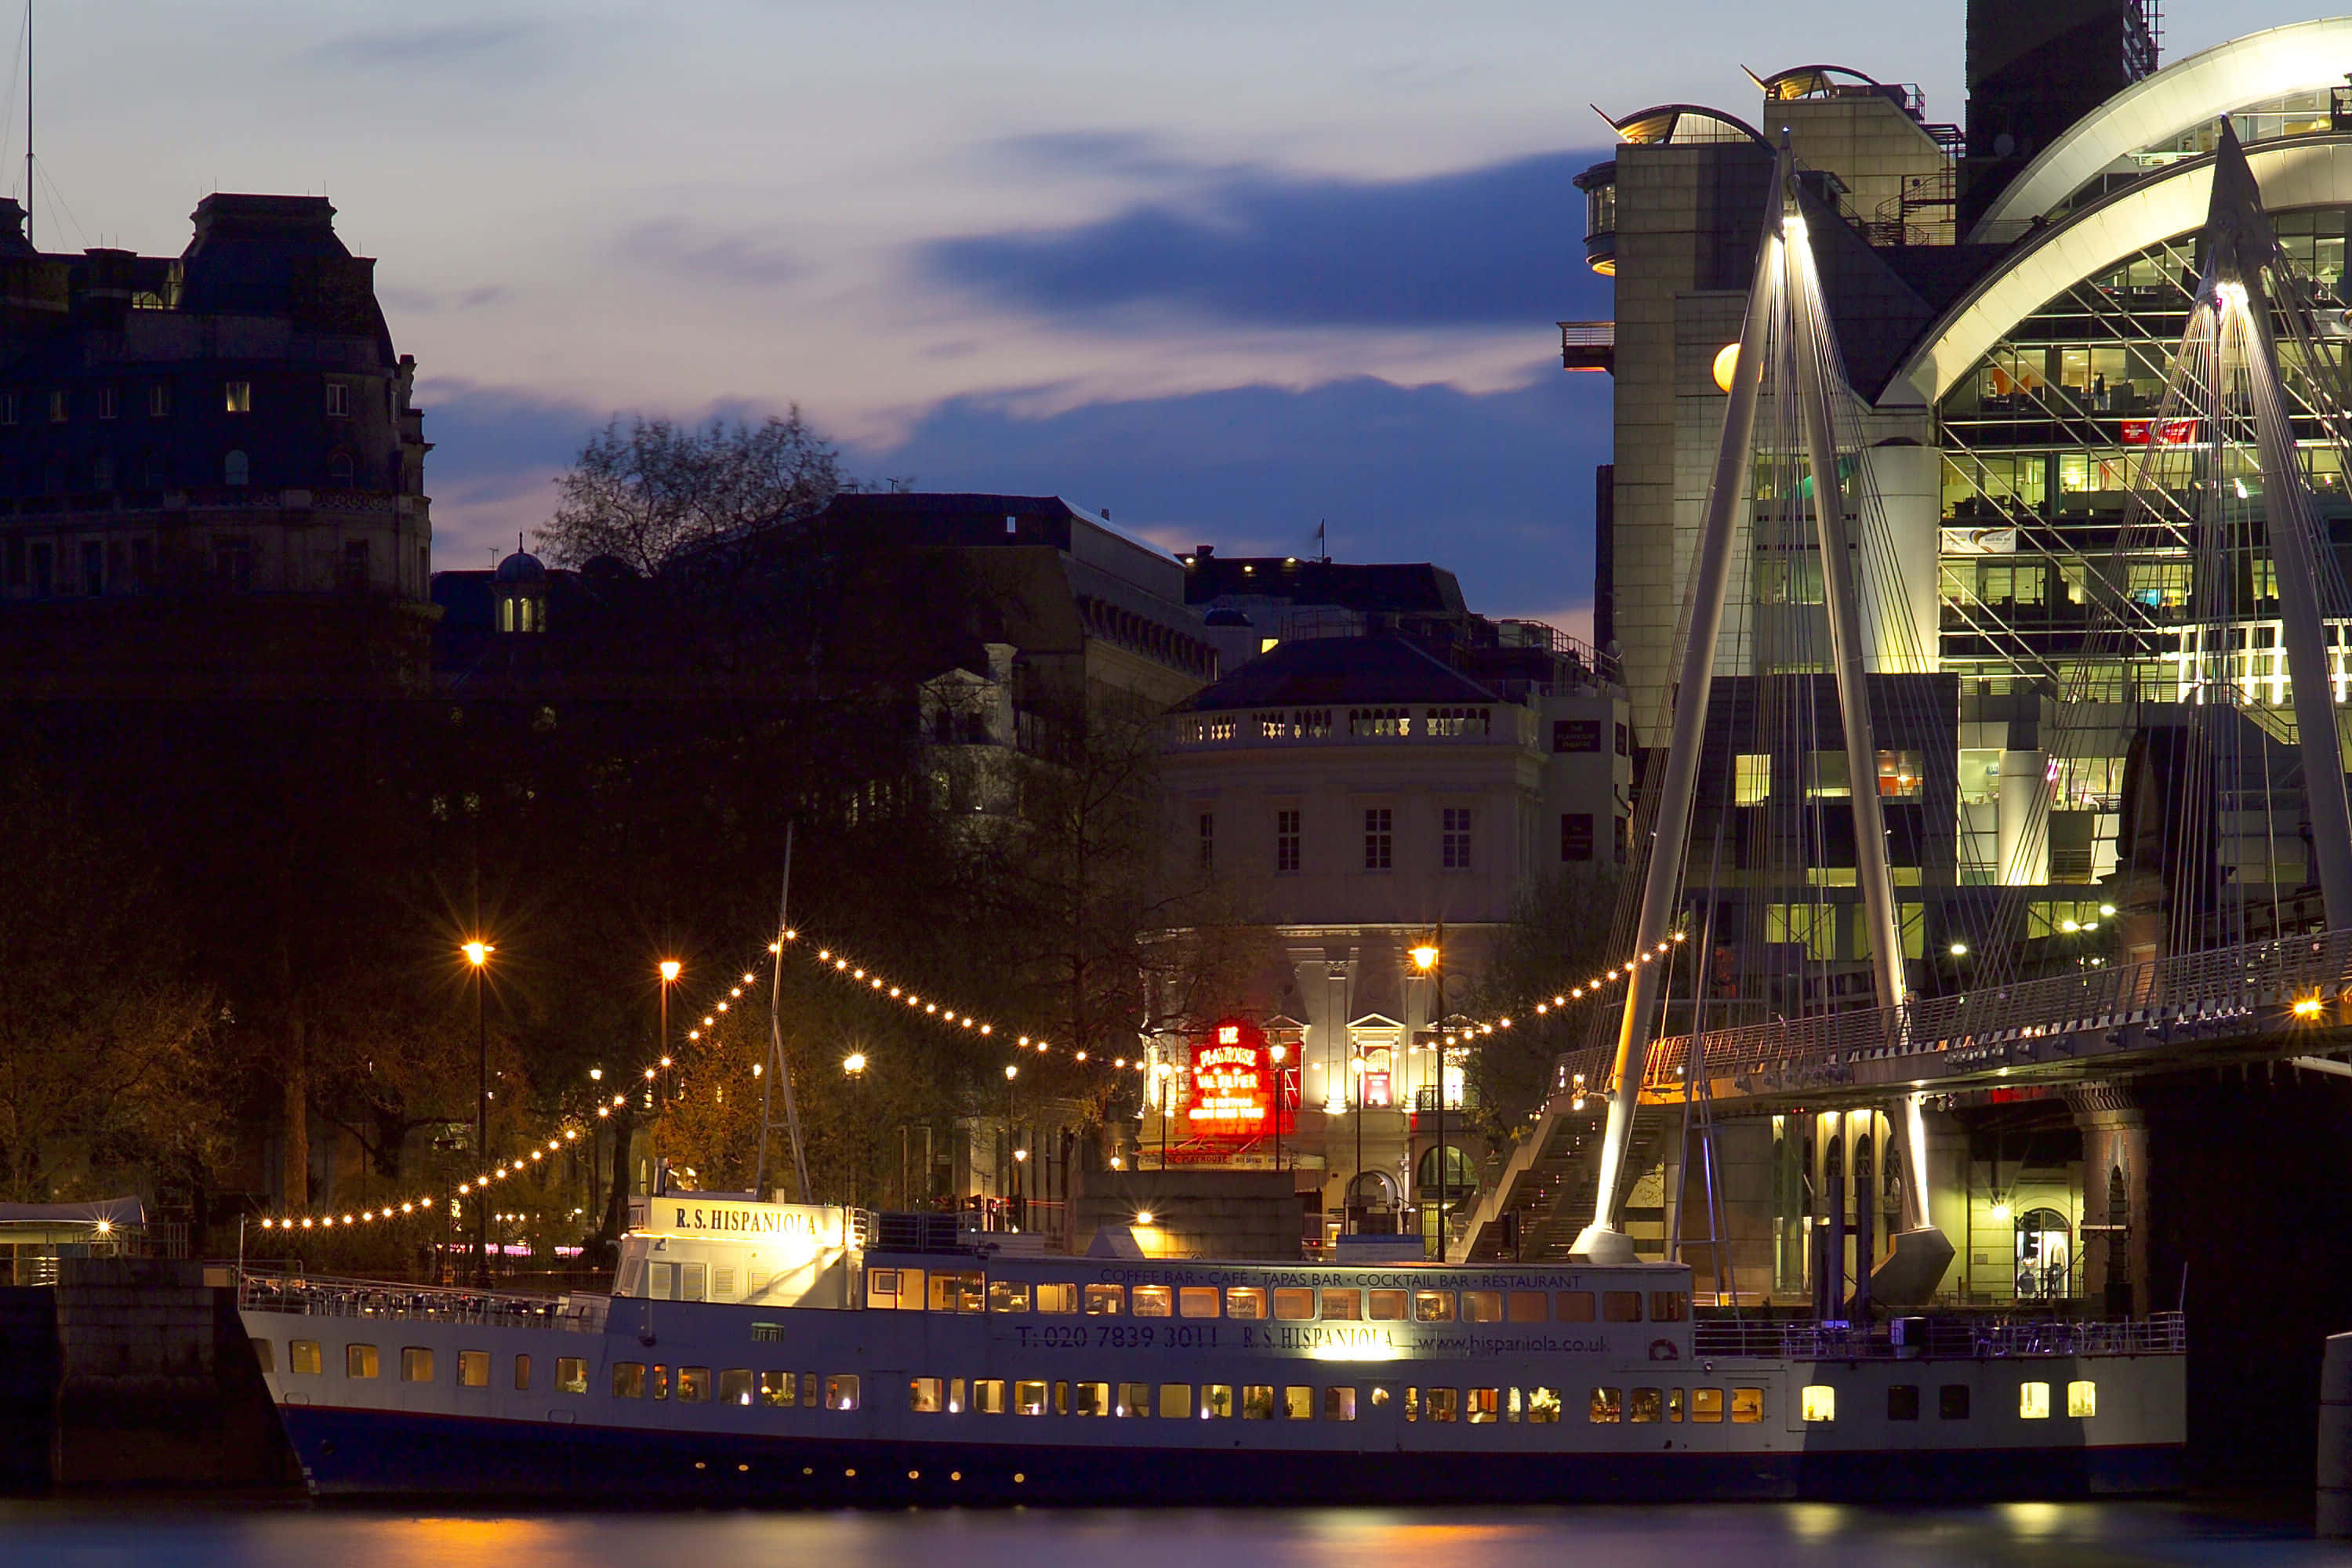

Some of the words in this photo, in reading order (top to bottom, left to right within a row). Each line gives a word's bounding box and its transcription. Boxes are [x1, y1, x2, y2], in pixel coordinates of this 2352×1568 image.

[1219, 1026, 1238, 1044] THE
[1200, 1047, 1256, 1068] PLAYHOUSE
[676, 1208, 690, 1229] R.
[695, 1208, 706, 1229] S.
[711, 1210, 815, 1235] HISPANIOLA
[1101, 1269, 1160, 1283] COFFEE
[1165, 1270, 1195, 1283] BAR
[1261, 1272, 1306, 1285] TAPAS
[1312, 1273, 1341, 1286] BAR
[1356, 1273, 1434, 1287] COCKTAIL
[1439, 1274, 1468, 1287] BAR
[1483, 1274, 1581, 1288] RESTAURANT
[1015, 1327, 1037, 1348] T:
[1044, 1327, 1087, 1348] 020
[1097, 1327, 1154, 1348] 7839
[1163, 1327, 1217, 1348] 3011
[1280, 1327, 1392, 1349] HISPANIOLA
[1418, 1334, 1608, 1354] www.hispaniola.co.uk
